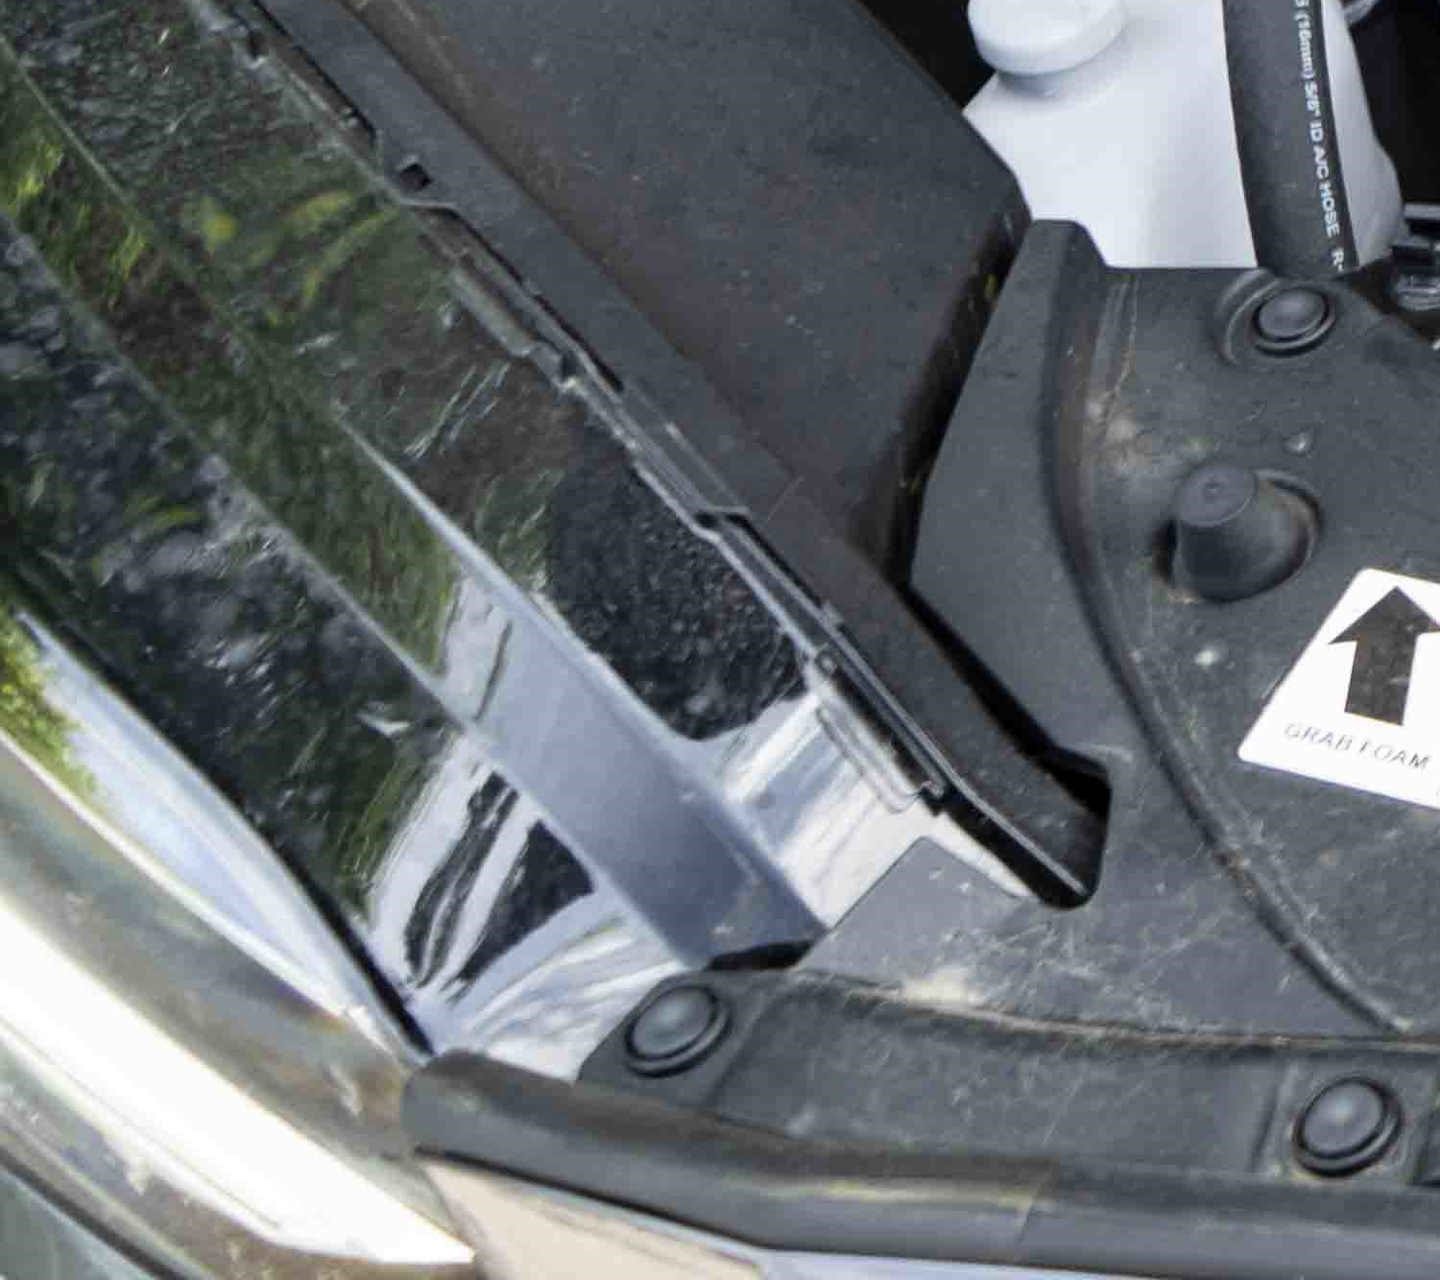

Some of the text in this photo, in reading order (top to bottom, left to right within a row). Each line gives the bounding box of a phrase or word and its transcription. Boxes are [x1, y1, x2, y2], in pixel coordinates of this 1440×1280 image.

[1309, 120, 1324, 143] ID
[1313, 147, 1329, 179] A/C
[1319, 183, 1339, 238] HOSE
